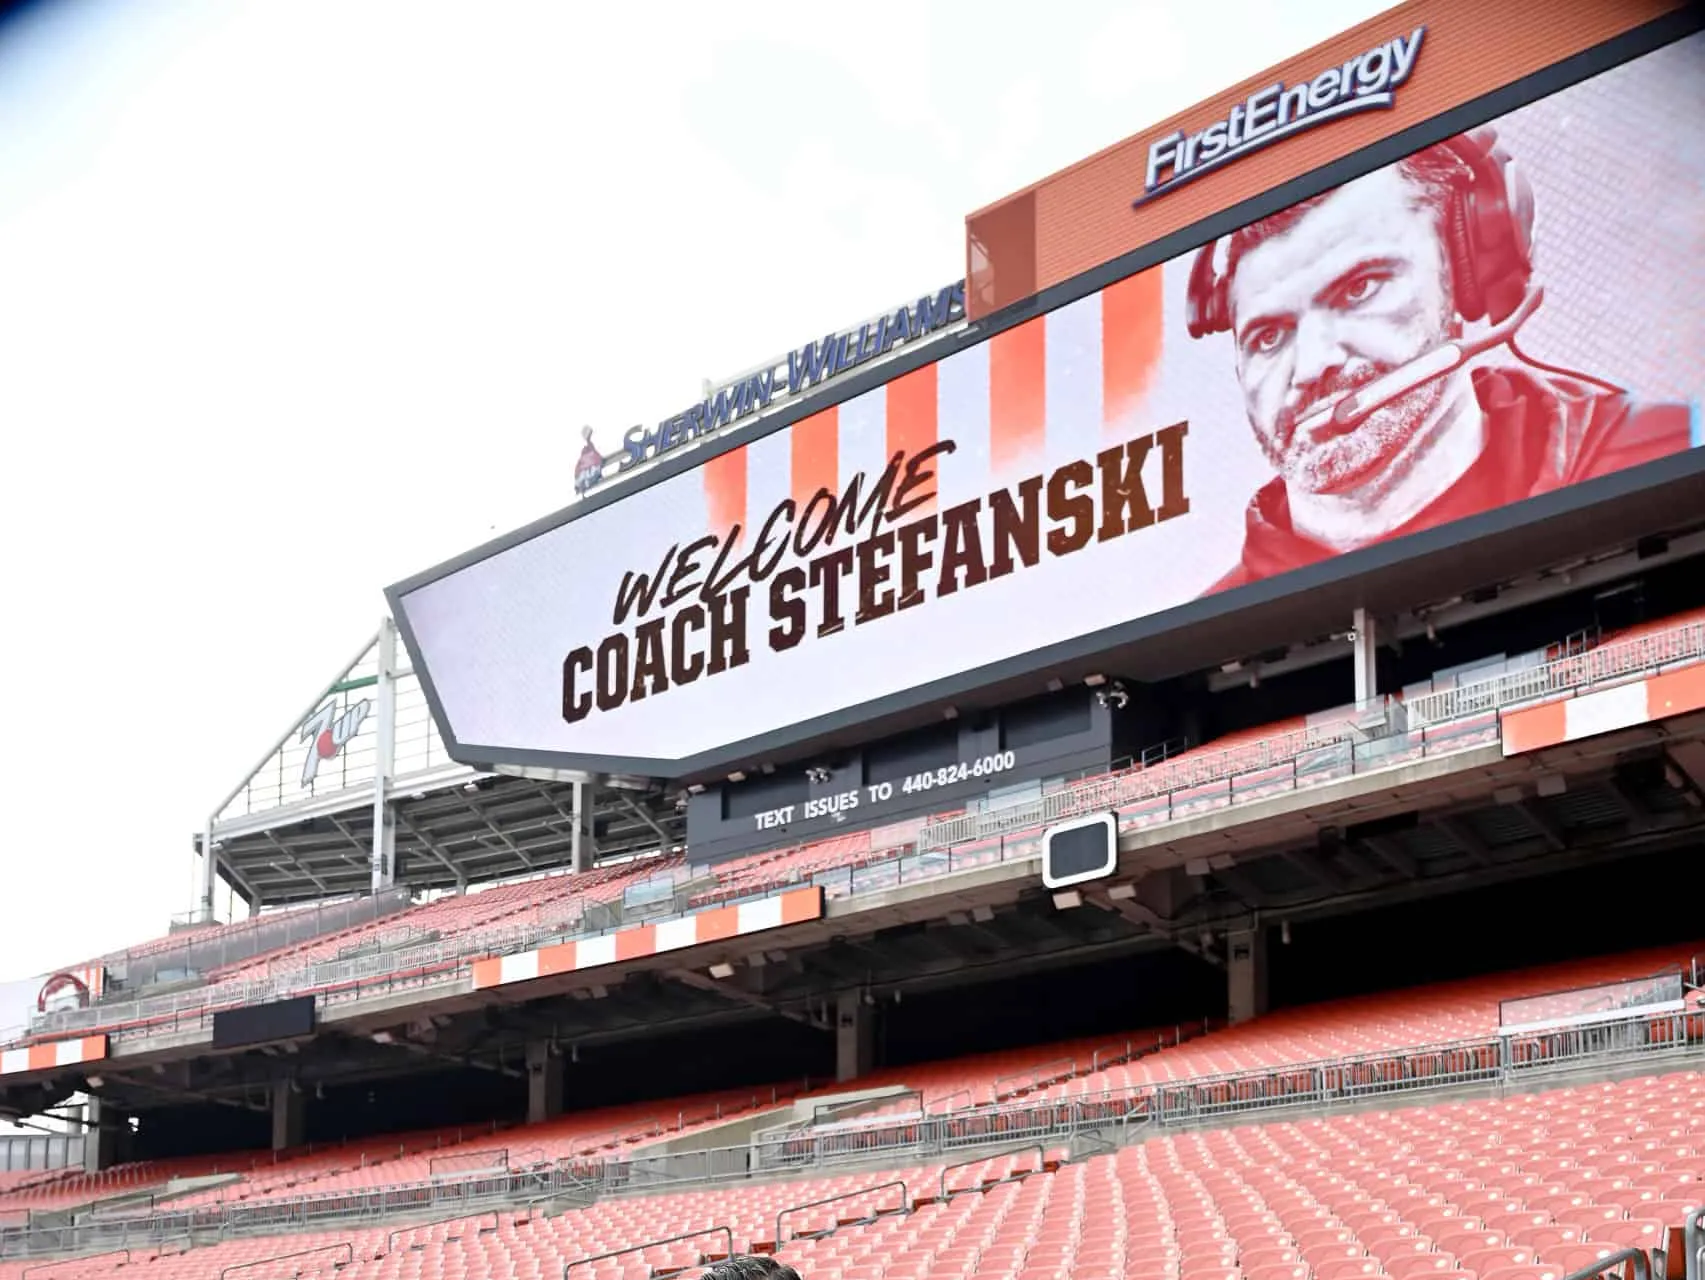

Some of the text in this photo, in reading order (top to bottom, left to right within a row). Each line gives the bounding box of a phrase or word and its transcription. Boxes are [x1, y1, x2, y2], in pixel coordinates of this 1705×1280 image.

[1146, 27, 1425, 190] FirstEnergy
[562, 421, 1190, 724] COACH STEFANSKI
[613, 440, 956, 625] WELCOME
[755, 751, 1016, 830] TEXT ISSUES TO 440-824-6000
